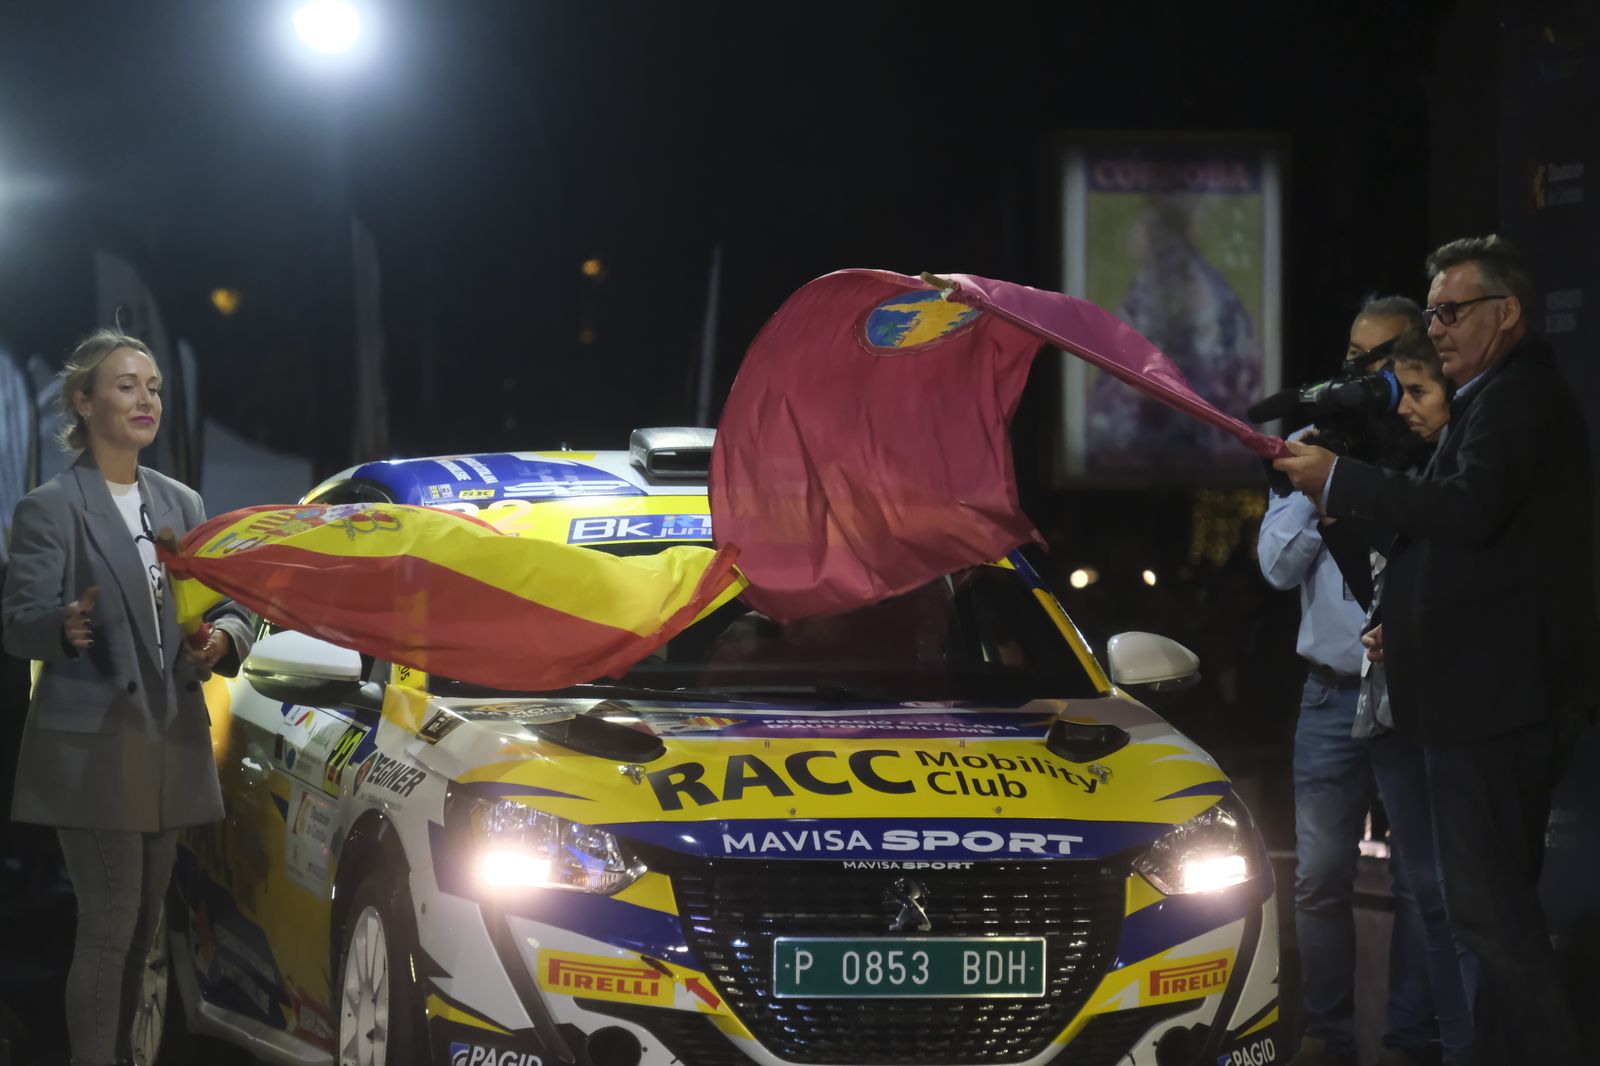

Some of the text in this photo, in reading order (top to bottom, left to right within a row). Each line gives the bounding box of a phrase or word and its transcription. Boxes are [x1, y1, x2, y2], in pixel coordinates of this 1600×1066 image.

[647, 749, 1100, 812] RACC Mobility
[926, 768, 1028, 800] Club
[722, 830, 1084, 855] MAVISA SPORT
[843, 861, 975, 870] MAVISA SPORT
[548, 958, 662, 997] PIRELLI
[794, 949, 1027, 986] P 0853 BDH
[1149, 958, 1228, 998] PIRELLI
[1231, 1037, 1276, 1066] PAGID
